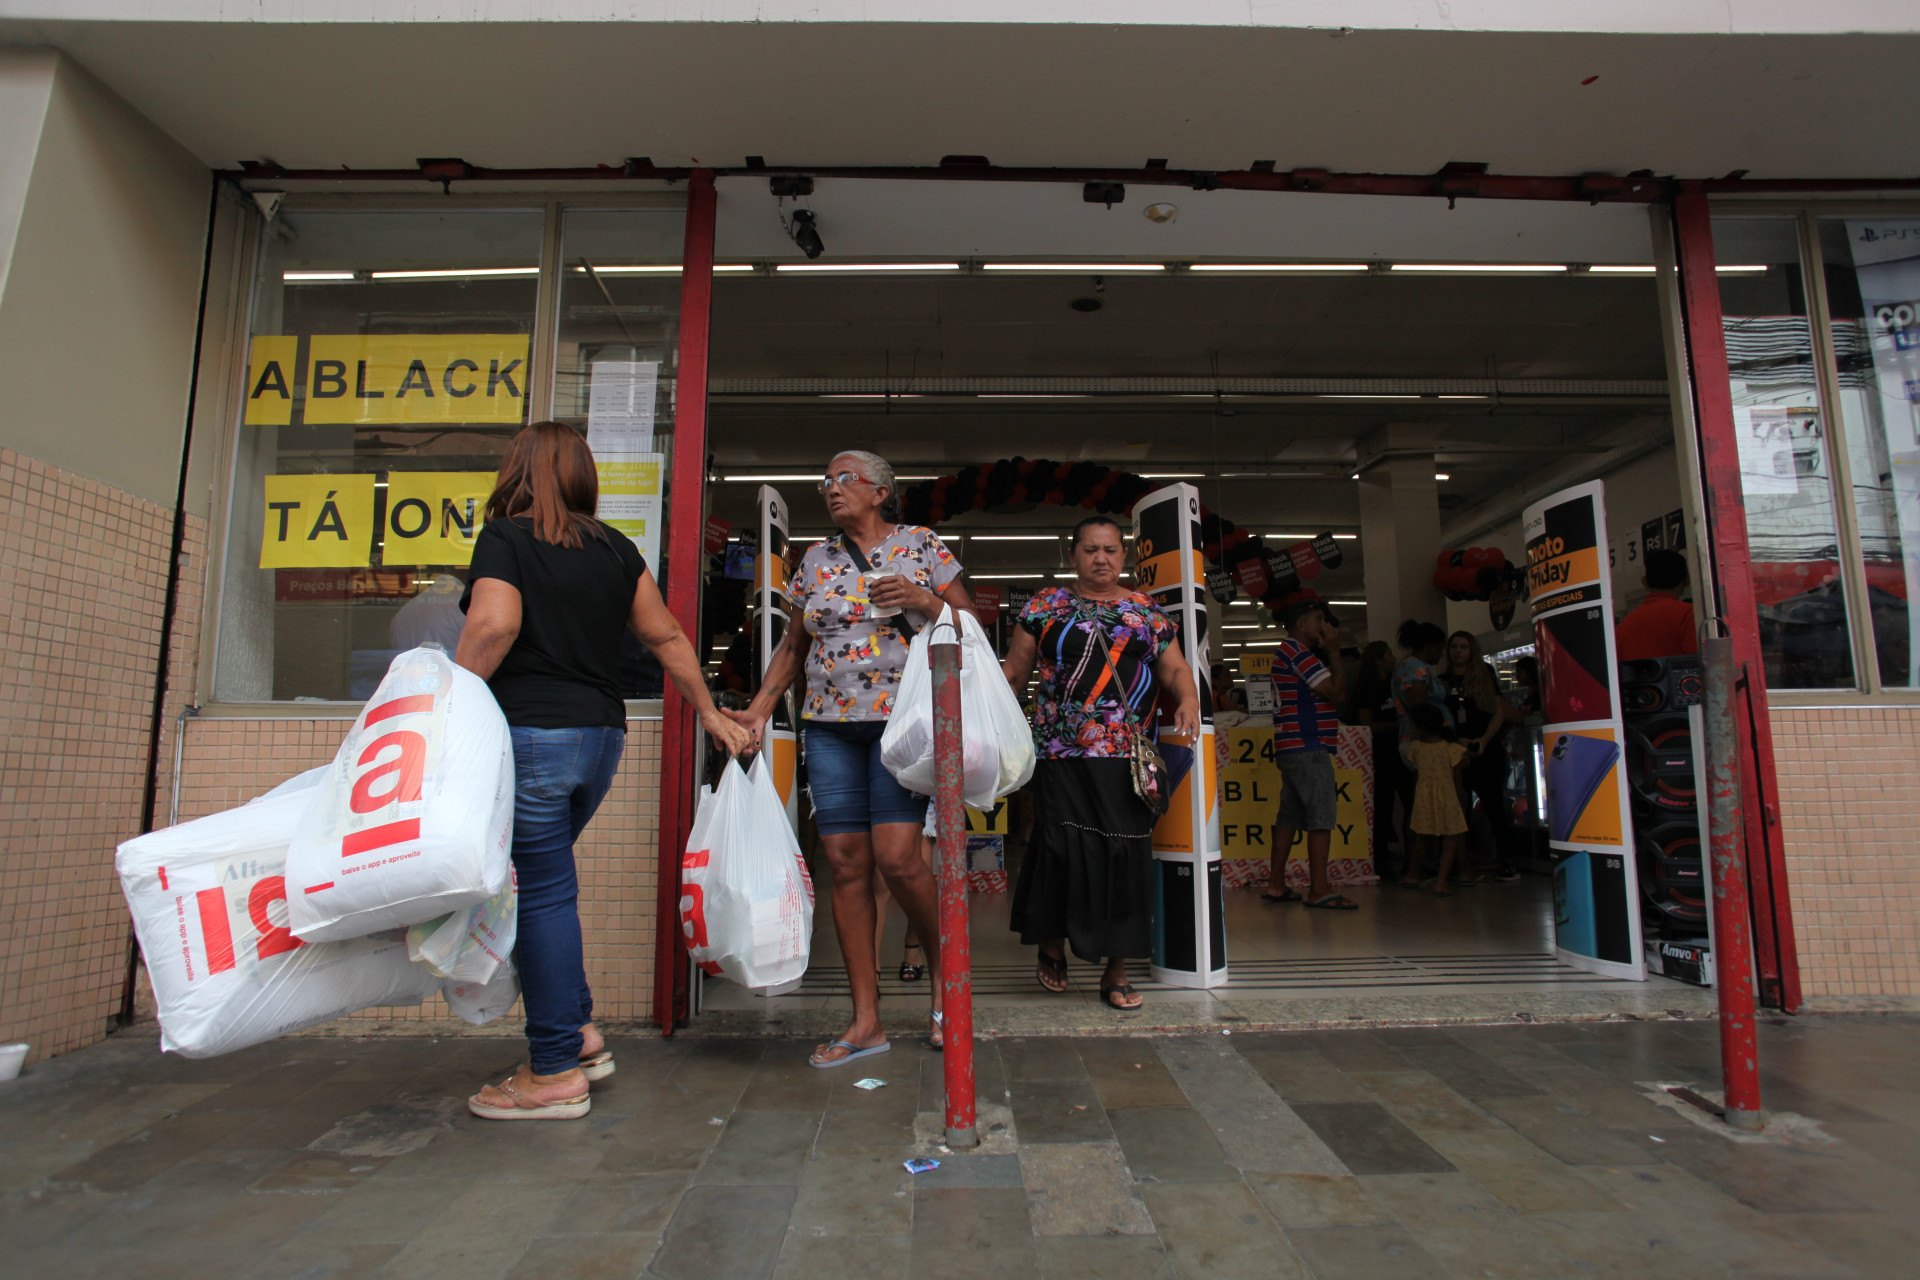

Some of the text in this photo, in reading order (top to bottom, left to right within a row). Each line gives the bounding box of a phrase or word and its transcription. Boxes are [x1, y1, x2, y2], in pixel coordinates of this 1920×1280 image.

[250, 358, 525, 399] A BLACK
[269, 490, 475, 542] TÁ ON
[1312, 536, 1332, 548] black
[1670, 522, 1680, 546] 7
[1316, 542, 1336, 554] friday
[1528, 536, 1566, 566] moto
[1628, 541, 1636, 562] 3
[1646, 536, 1662, 552] R$
[1268, 554, 1288, 566] black
[1272, 560, 1292, 572] friday
[1208, 572, 1228, 581] black
[1211, 578, 1232, 588] friday
[1529, 560, 1570, 591] friday
[1010, 600, 1024, 608] frid
[1547, 590, 1584, 608] ESPECIAIS
[350, 730, 427, 814] a
[1224, 780, 1352, 802] BLK
[342, 866, 360, 876] baixe
[368, 860, 381, 868] app
[388, 850, 421, 864] aproveite
[1606, 858, 1620, 869] 5G
[176, 896, 184, 916] baixe
[178, 924, 187, 938] app
[1662, 943, 1698, 962] Amvox
[182, 946, 194, 982] aproveite
